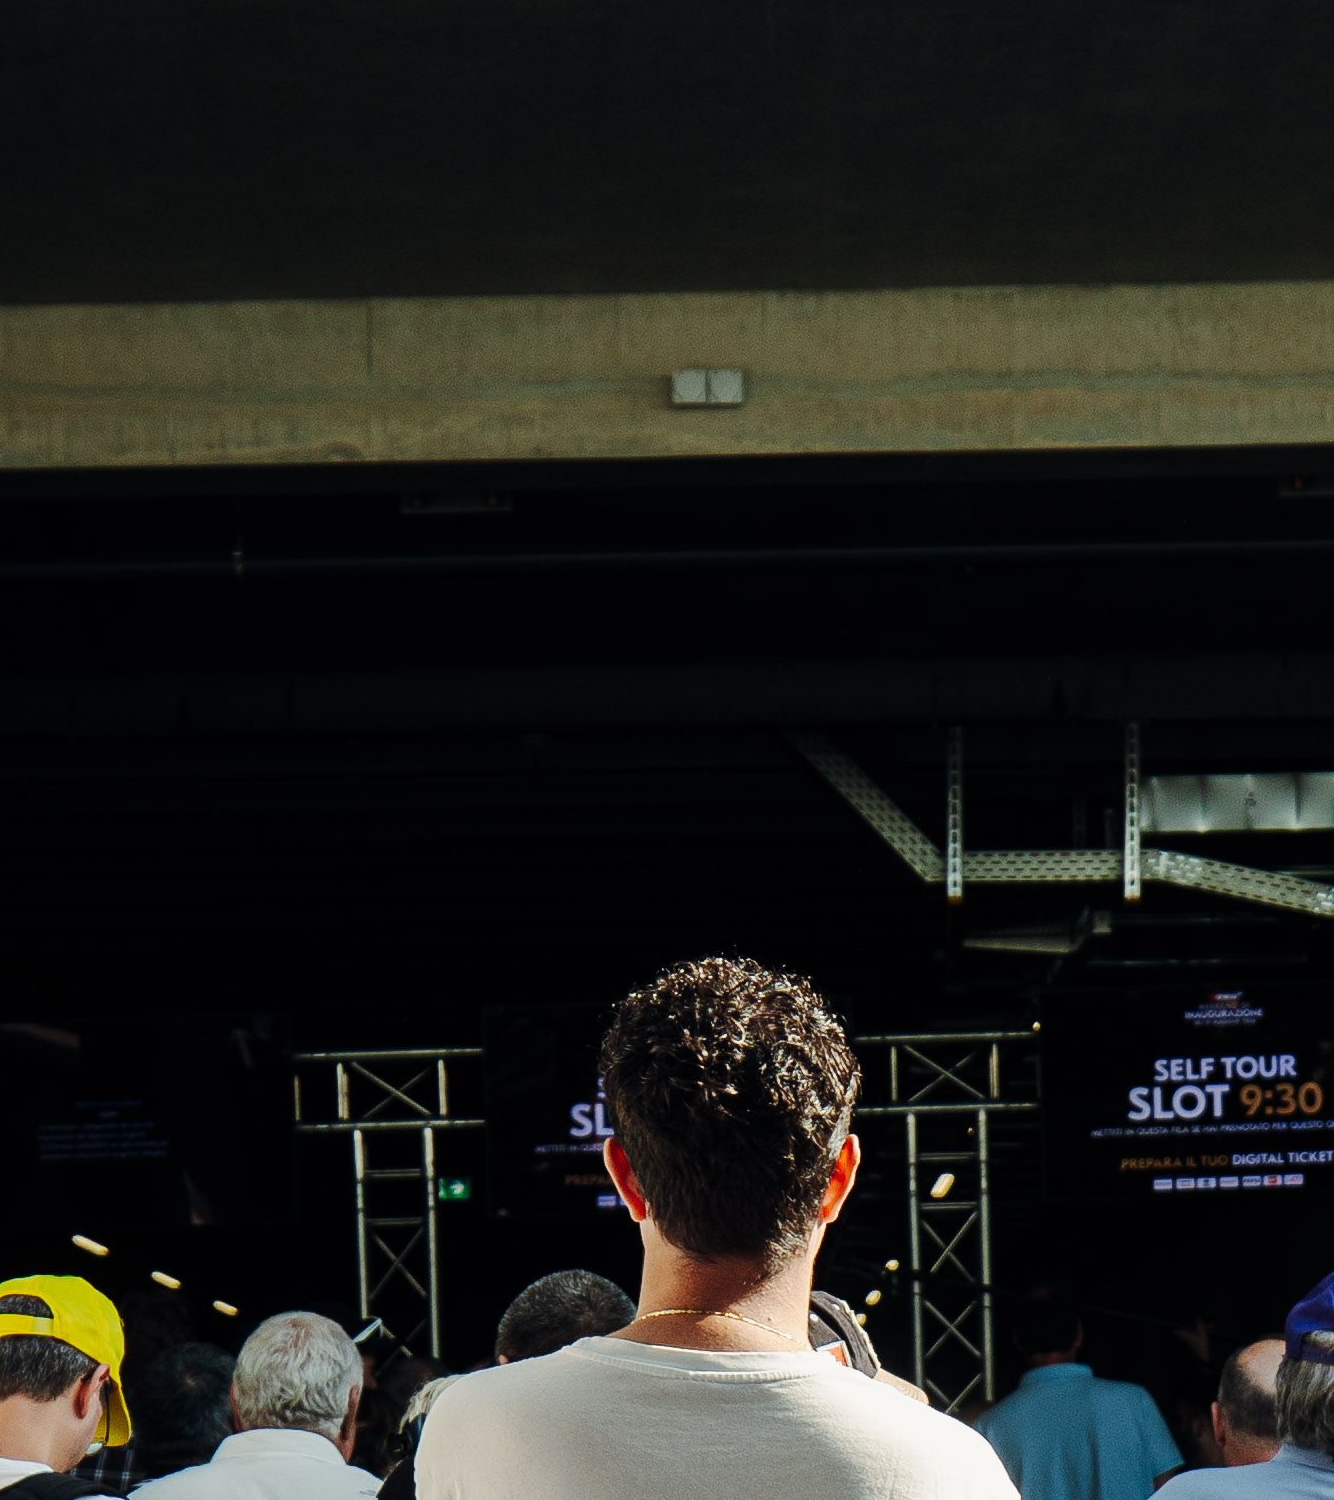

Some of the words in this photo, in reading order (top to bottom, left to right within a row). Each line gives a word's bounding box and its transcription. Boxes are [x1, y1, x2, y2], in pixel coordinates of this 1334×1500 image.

[1154, 1057, 1214, 1081] SELF
[1220, 1054, 1296, 1079] TOUR
[1128, 1084, 1229, 1121] SLOT
[1239, 1081, 1323, 1116] 9:30
[570, 1103, 615, 1137] SL
[1121, 1156, 1182, 1170] PREPARA
[1186, 1156, 1198, 1167] IL
[1201, 1155, 1228, 1167] TUO
[1232, 1152, 1285, 1166] DIGITAL
[1287, 1150, 1334, 1163] TICKET
